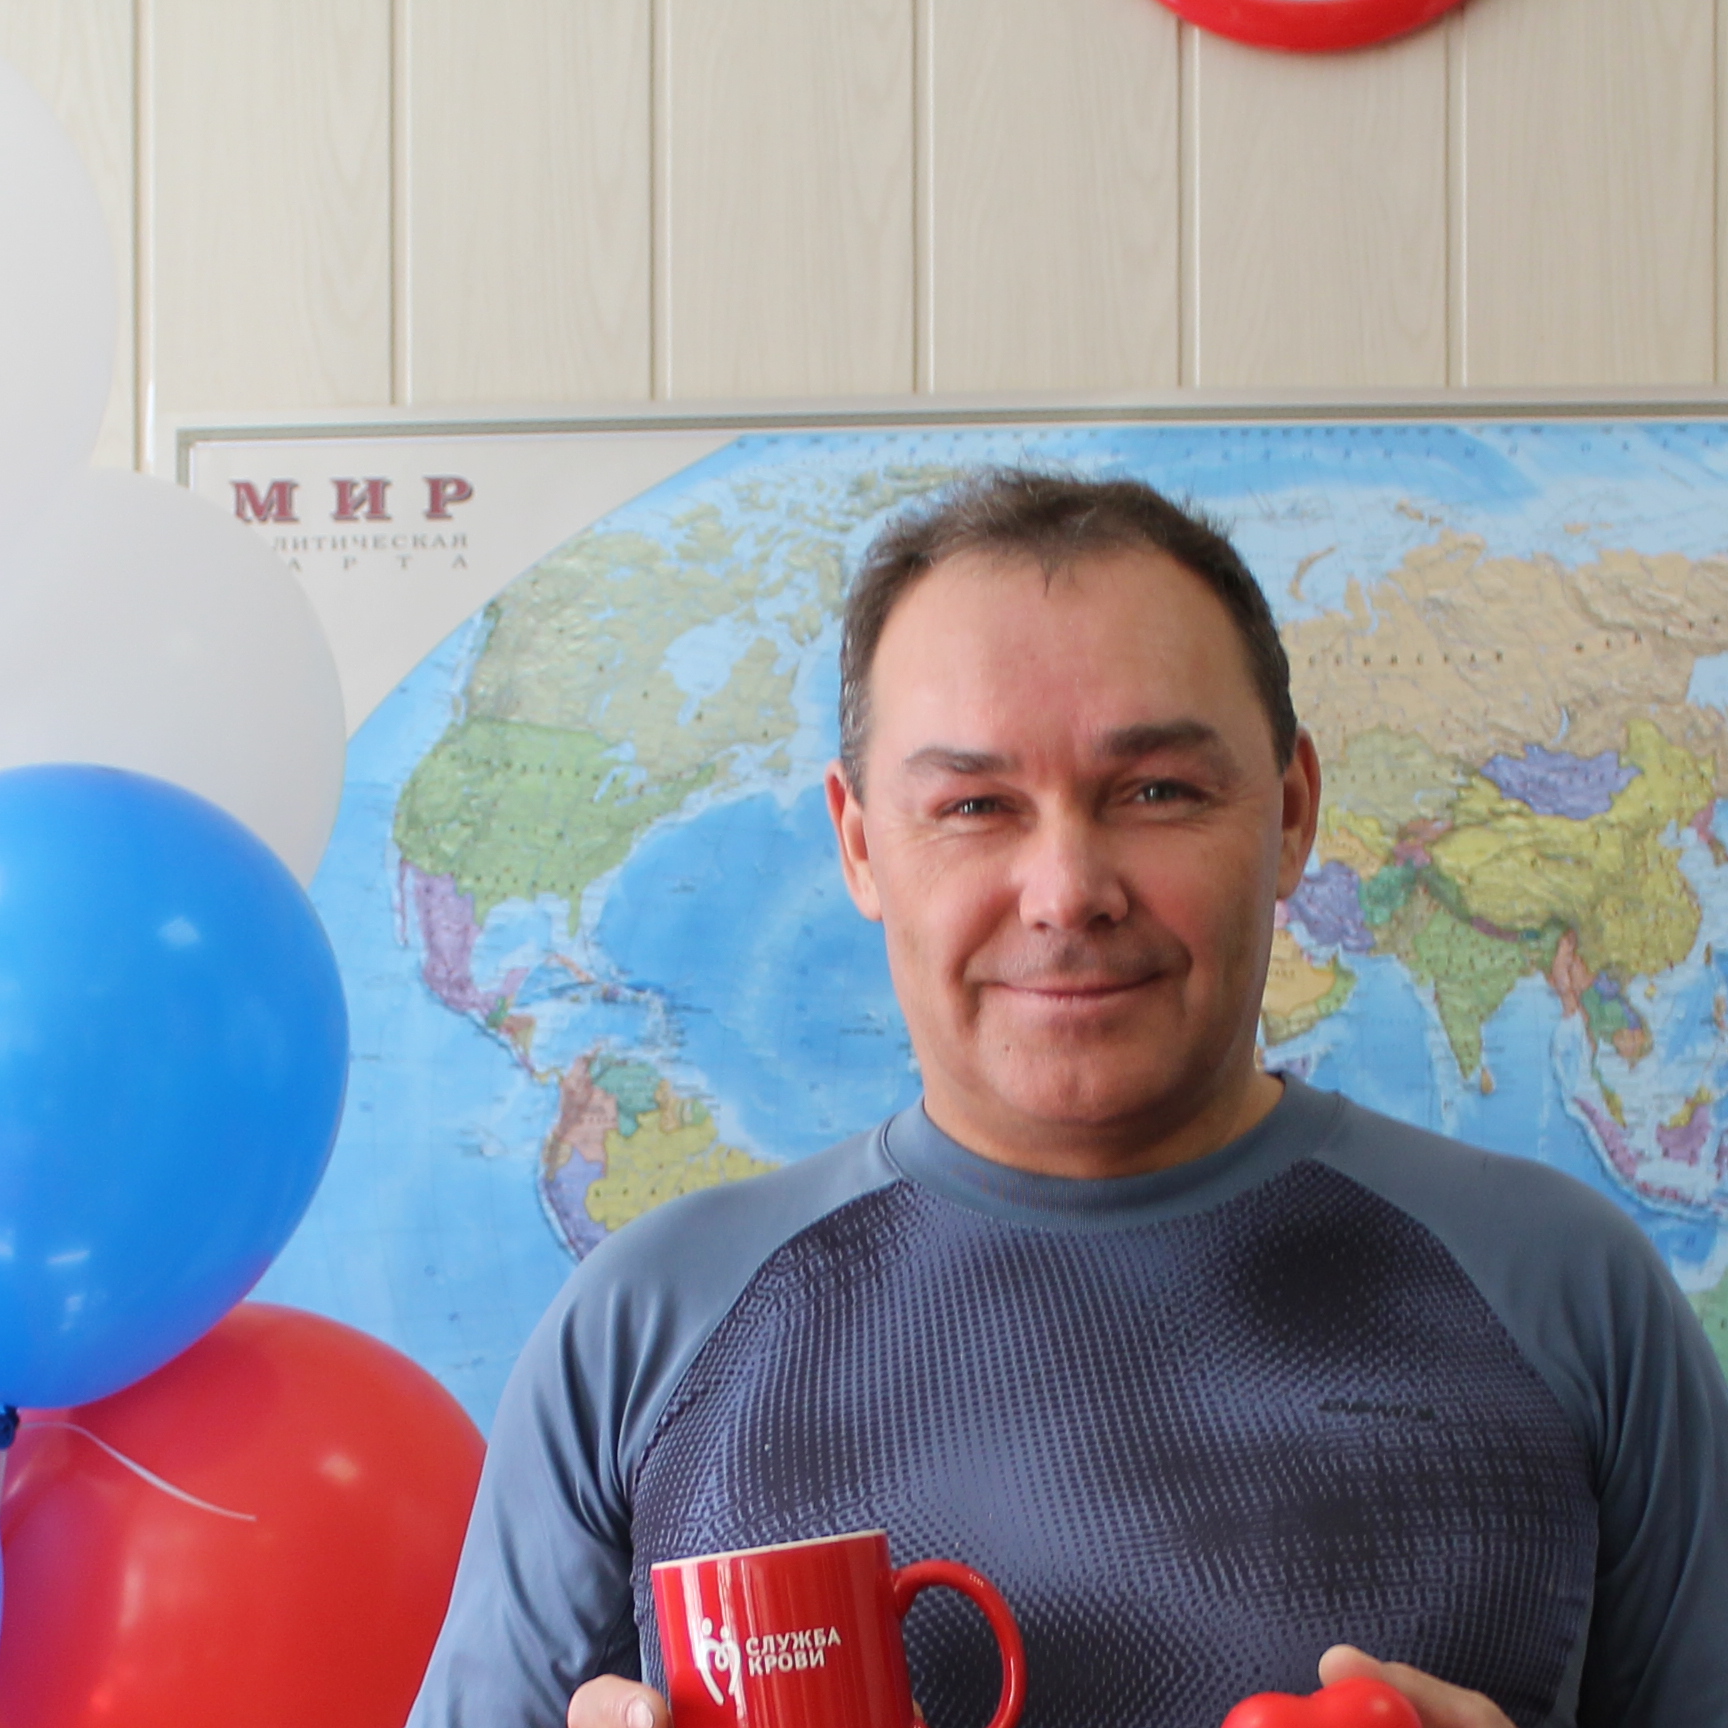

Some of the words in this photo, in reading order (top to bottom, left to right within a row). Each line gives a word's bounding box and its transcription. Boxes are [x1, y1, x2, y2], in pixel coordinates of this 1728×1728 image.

[230, 476, 475, 523] МИР
[273, 533, 468, 552] ЛИТИЧЕСКАЯ
[288, 554, 468, 572] АРТА
[745, 1626, 842, 1656] СЛУЖБА
[748, 1649, 826, 1677] КРОВИ
